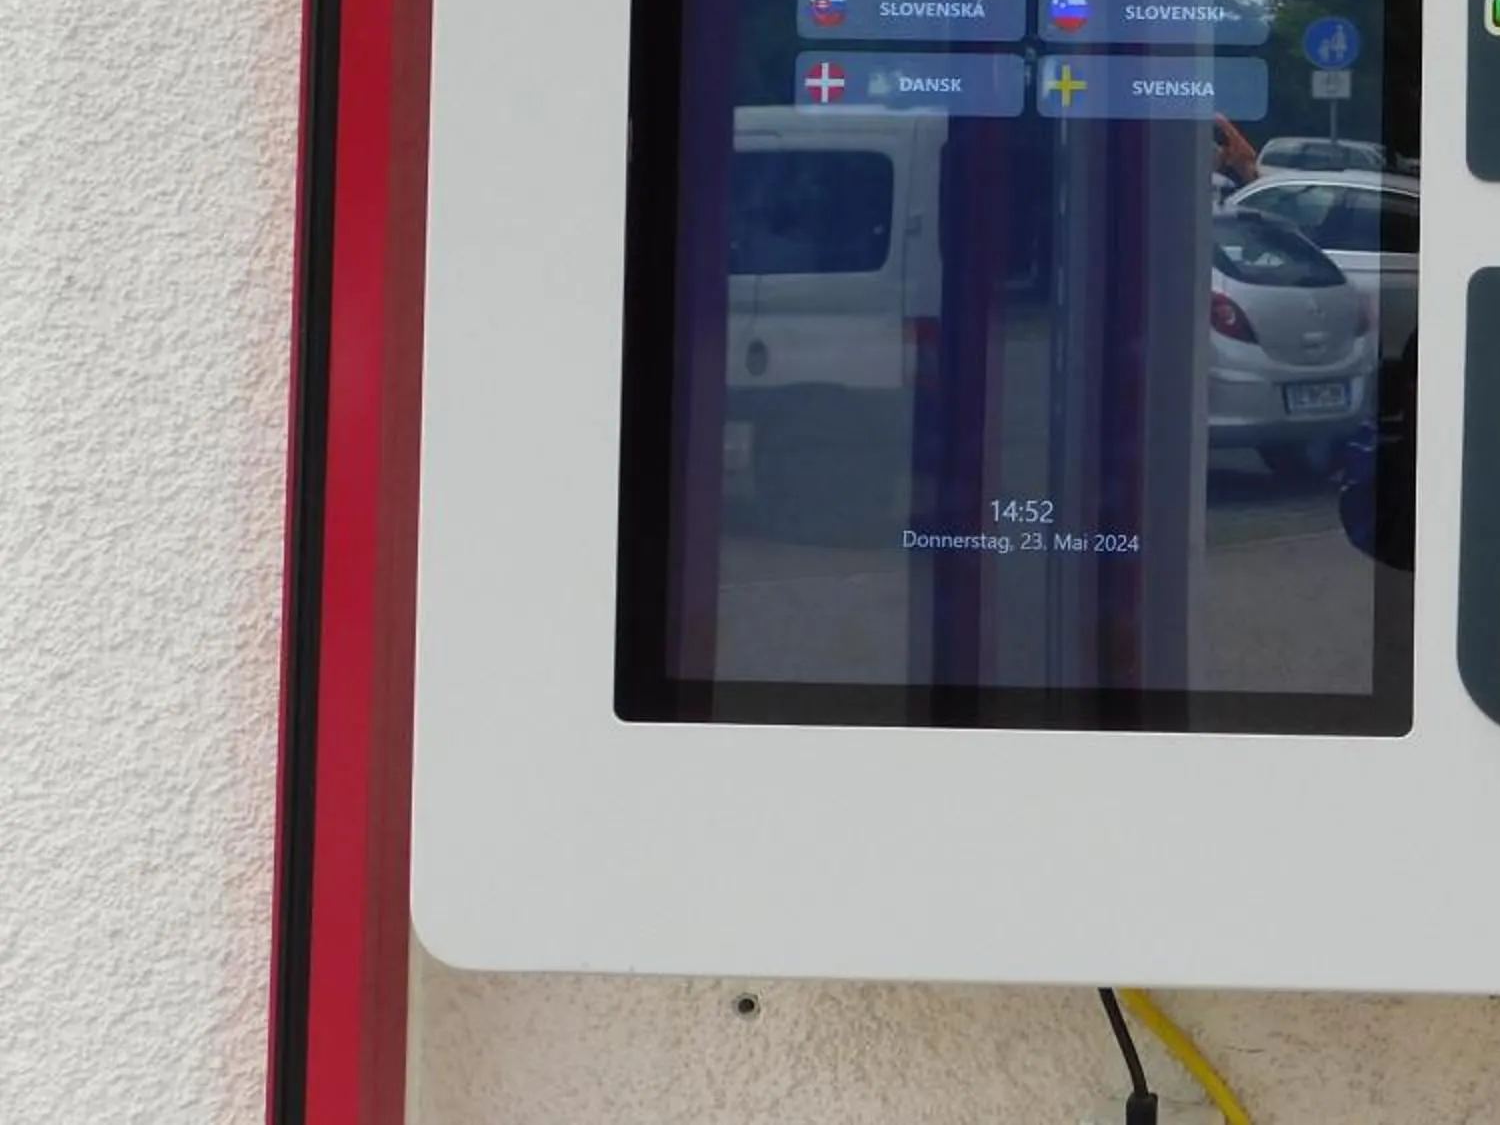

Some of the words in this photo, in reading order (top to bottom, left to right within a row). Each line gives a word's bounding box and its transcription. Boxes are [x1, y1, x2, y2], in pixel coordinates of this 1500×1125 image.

[900, 77, 962, 92] DANSK
[1132, 80, 1215, 96] SVENSKA
[991, 500, 1054, 524] 14:52
[902, 531, 1014, 553] Donnerstag,
[1020, 532, 1047, 552] 23.
[1054, 533, 1088, 552] Mai
[1094, 533, 1139, 552] 2024
